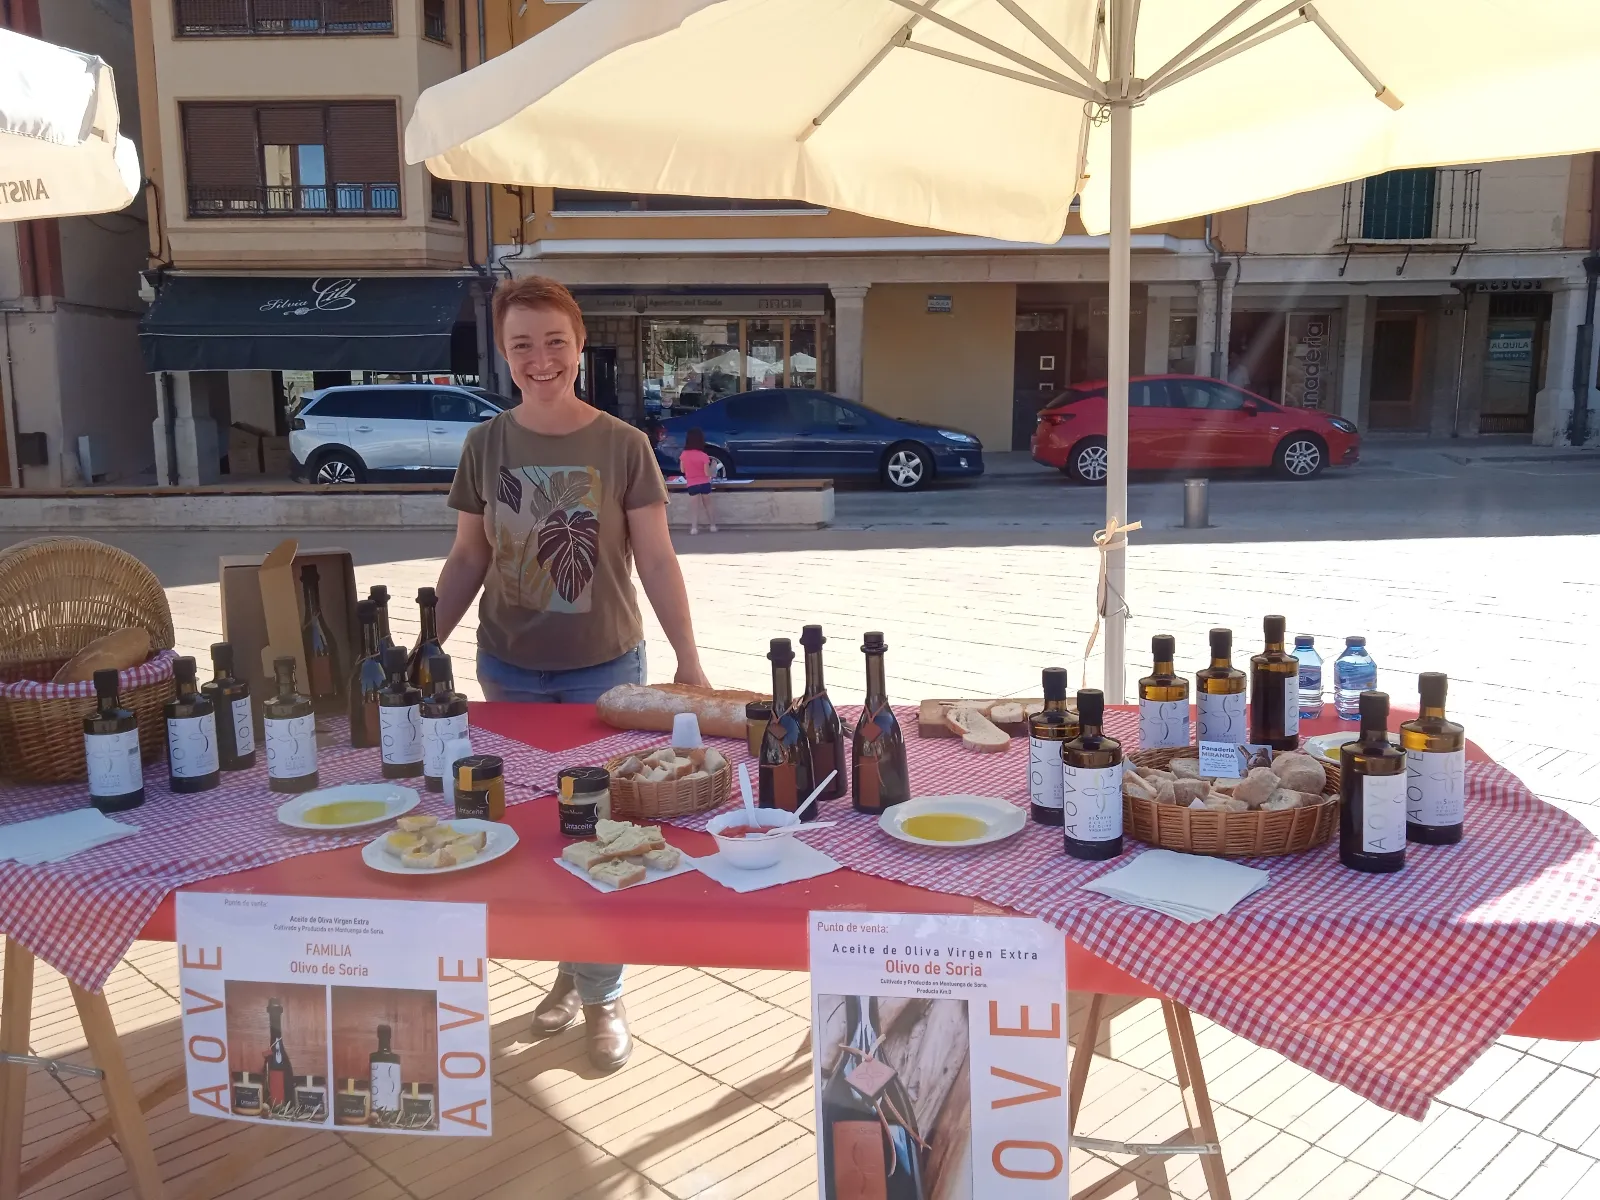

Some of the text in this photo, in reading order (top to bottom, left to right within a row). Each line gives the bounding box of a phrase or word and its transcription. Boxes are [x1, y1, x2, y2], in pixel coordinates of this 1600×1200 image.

[260, 277, 361, 311] Silvia Cid
[1491, 341, 1529, 349] ALQUILA
[169, 720, 187, 776] AOVE
[235, 699, 252, 752] AOVE
[381, 707, 395, 763] AOVE
[1031, 739, 1044, 805] AOVE
[1407, 752, 1423, 823] AOVE
[564, 822, 593, 830] Untaceite
[1064, 766, 1078, 838] AOVE
[1368, 780, 1388, 851] AOVE
[289, 915, 370, 926] Aceite de Oliva Virgen Extra
[817, 921, 889, 934] Punto de venta:
[290, 961, 369, 977] Olivo de Soria
[306, 943, 352, 957] FAMILIA
[832, 943, 1038, 960] Aceite de Oliva Virgen Extra
[885, 959, 983, 977] Olivo de Soria
[182, 944, 230, 1115] AOVE
[438, 956, 488, 1131] AOVE
[989, 1000, 1063, 1181] OVE
